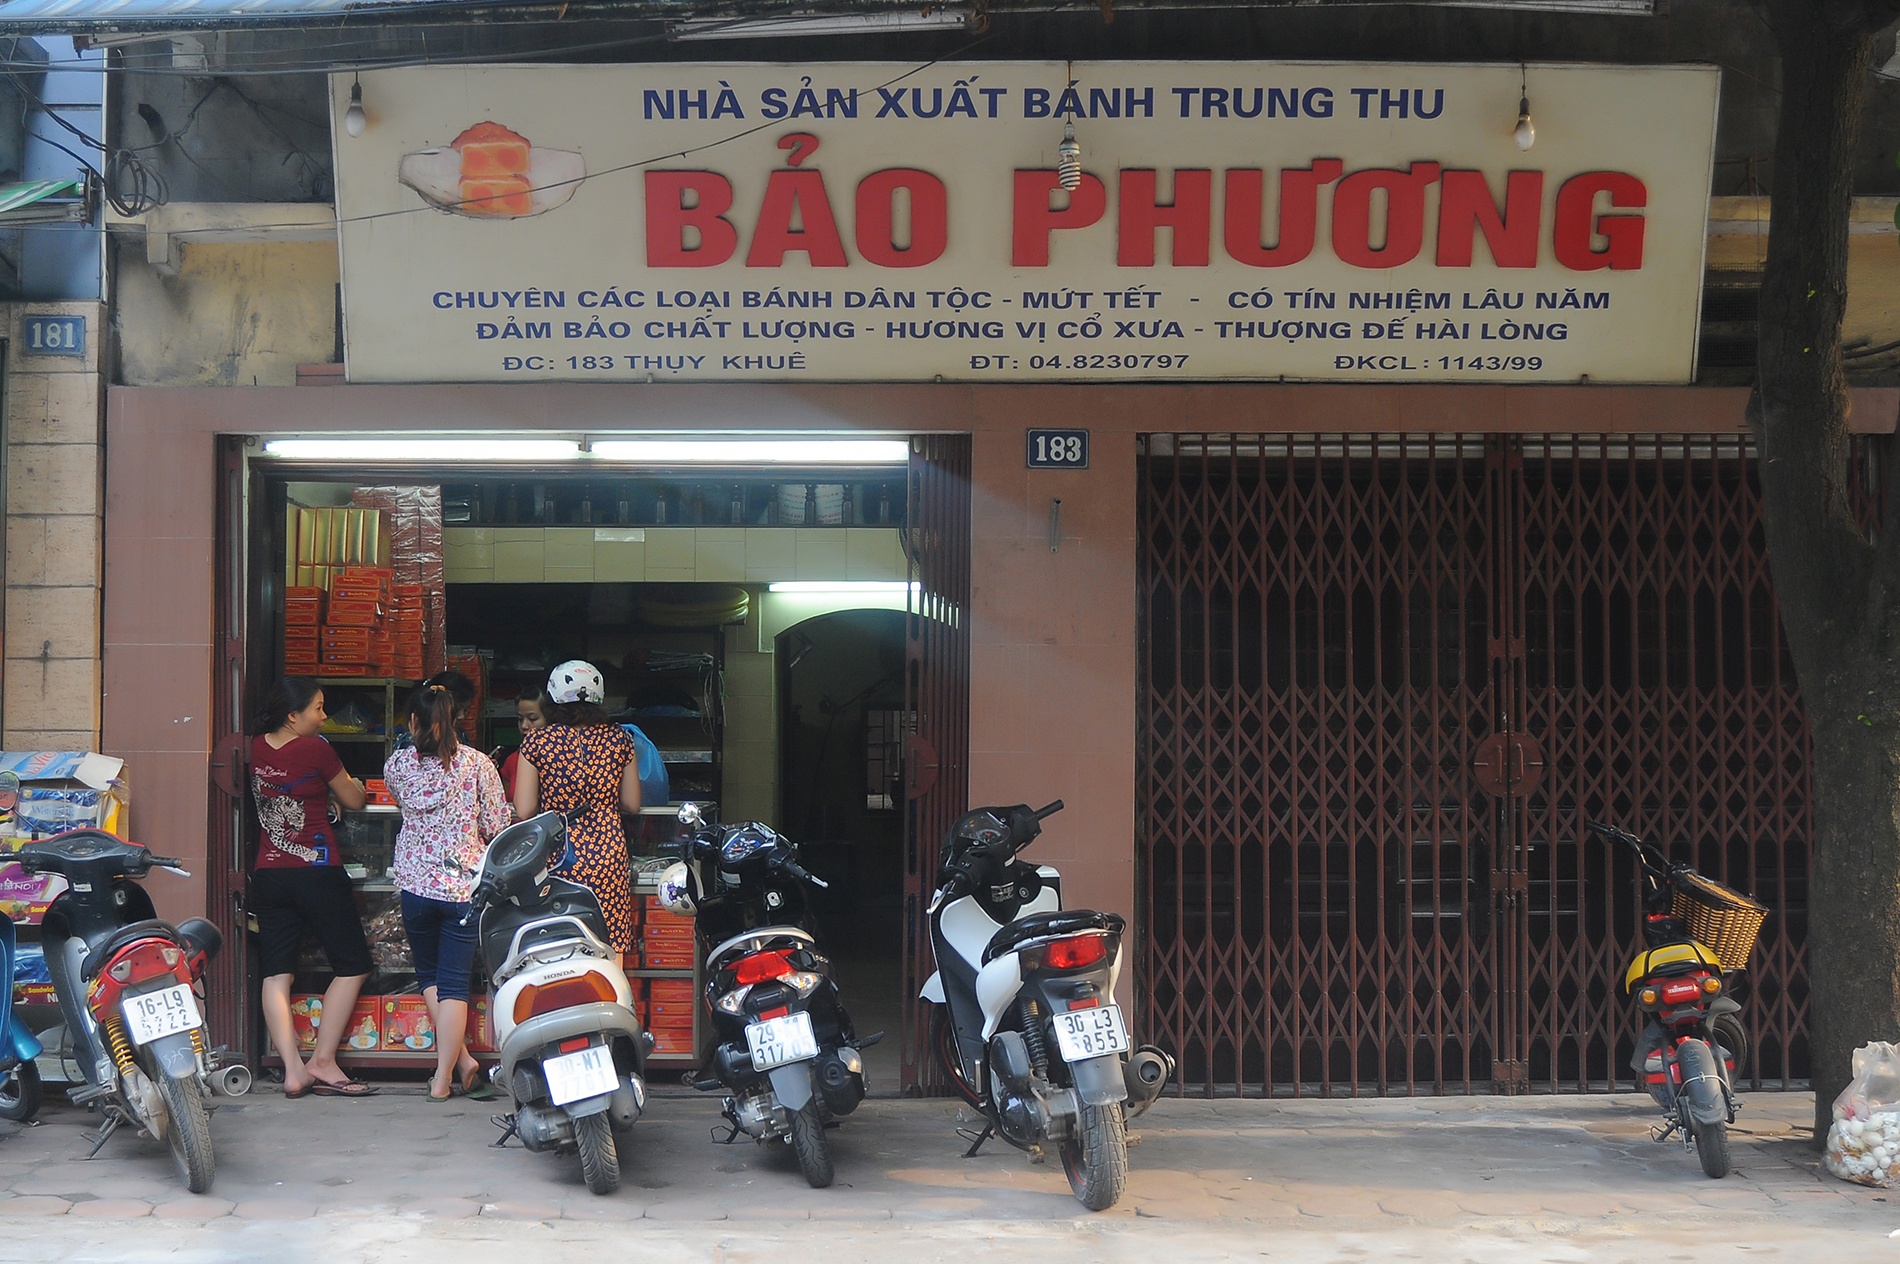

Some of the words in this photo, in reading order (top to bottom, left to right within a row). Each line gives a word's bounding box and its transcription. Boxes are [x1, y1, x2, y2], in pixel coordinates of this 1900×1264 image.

[643, 80, 746, 120] NHÀ
[761, 76, 858, 119] SẢN
[876, 75, 1007, 118] XUẤT
[1023, 80, 1154, 118] BÁNH
[1172, 87, 1334, 118] TRUNG
[1350, 88, 1444, 119] THU
[645, 133, 947, 267] BẢO
[1012, 158, 1648, 271] PHƯƠNG
[433, 287, 566, 309] CHUYÊN
[578, 286, 645, 308] CÁC
[657, 291, 731, 312] LOẠI
[743, 286, 832, 308] BÁNH
[845, 286, 916, 308] DÂN
[926, 286, 992, 312] TỘC
[1023, 288, 1094, 309] MỨT
[1103, 284, 1162, 308] TẾT
[1228, 287, 1274, 308] CÓ
[1284, 287, 1336, 309] TÍN
[1349, 287, 1451, 312] NHIỆM
[1463, 288, 1524, 309] LÂU
[1536, 287, 1610, 309] NĂM
[32, 322, 75, 348] 181
[476, 315, 552, 339] ĐẢM
[564, 315, 631, 338] BẢO
[644, 314, 731, 338] CHẤT
[743, 319, 855, 343] LƯỢNG
[887, 319, 1004, 338] HƯƠNG
[1016, 322, 1046, 343] VỊ
[1057, 311, 1102, 338] CỔ
[1115, 319, 1184, 338] XƯA
[1214, 319, 1351, 343] THƯỢNG
[1362, 316, 1409, 339] ĐẾ
[1416, 317, 1470, 340] HÀI
[1481, 319, 1568, 340] LÒNG
[502, 356, 555, 370] ĐC:
[566, 356, 615, 370] 183
[624, 356, 706, 373] THỤY
[723, 352, 806, 370] KHUÊ
[969, 355, 1019, 369] ĐT:
[1029, 355, 1190, 369] 04.8230797
[1438, 357, 1543, 371] 1143/99
[1036, 435, 1082, 462] 183
[31, 905, 47, 913] Sand
[543, 969, 576, 980] HONDA
[136, 990, 184, 1018] 16-L9
